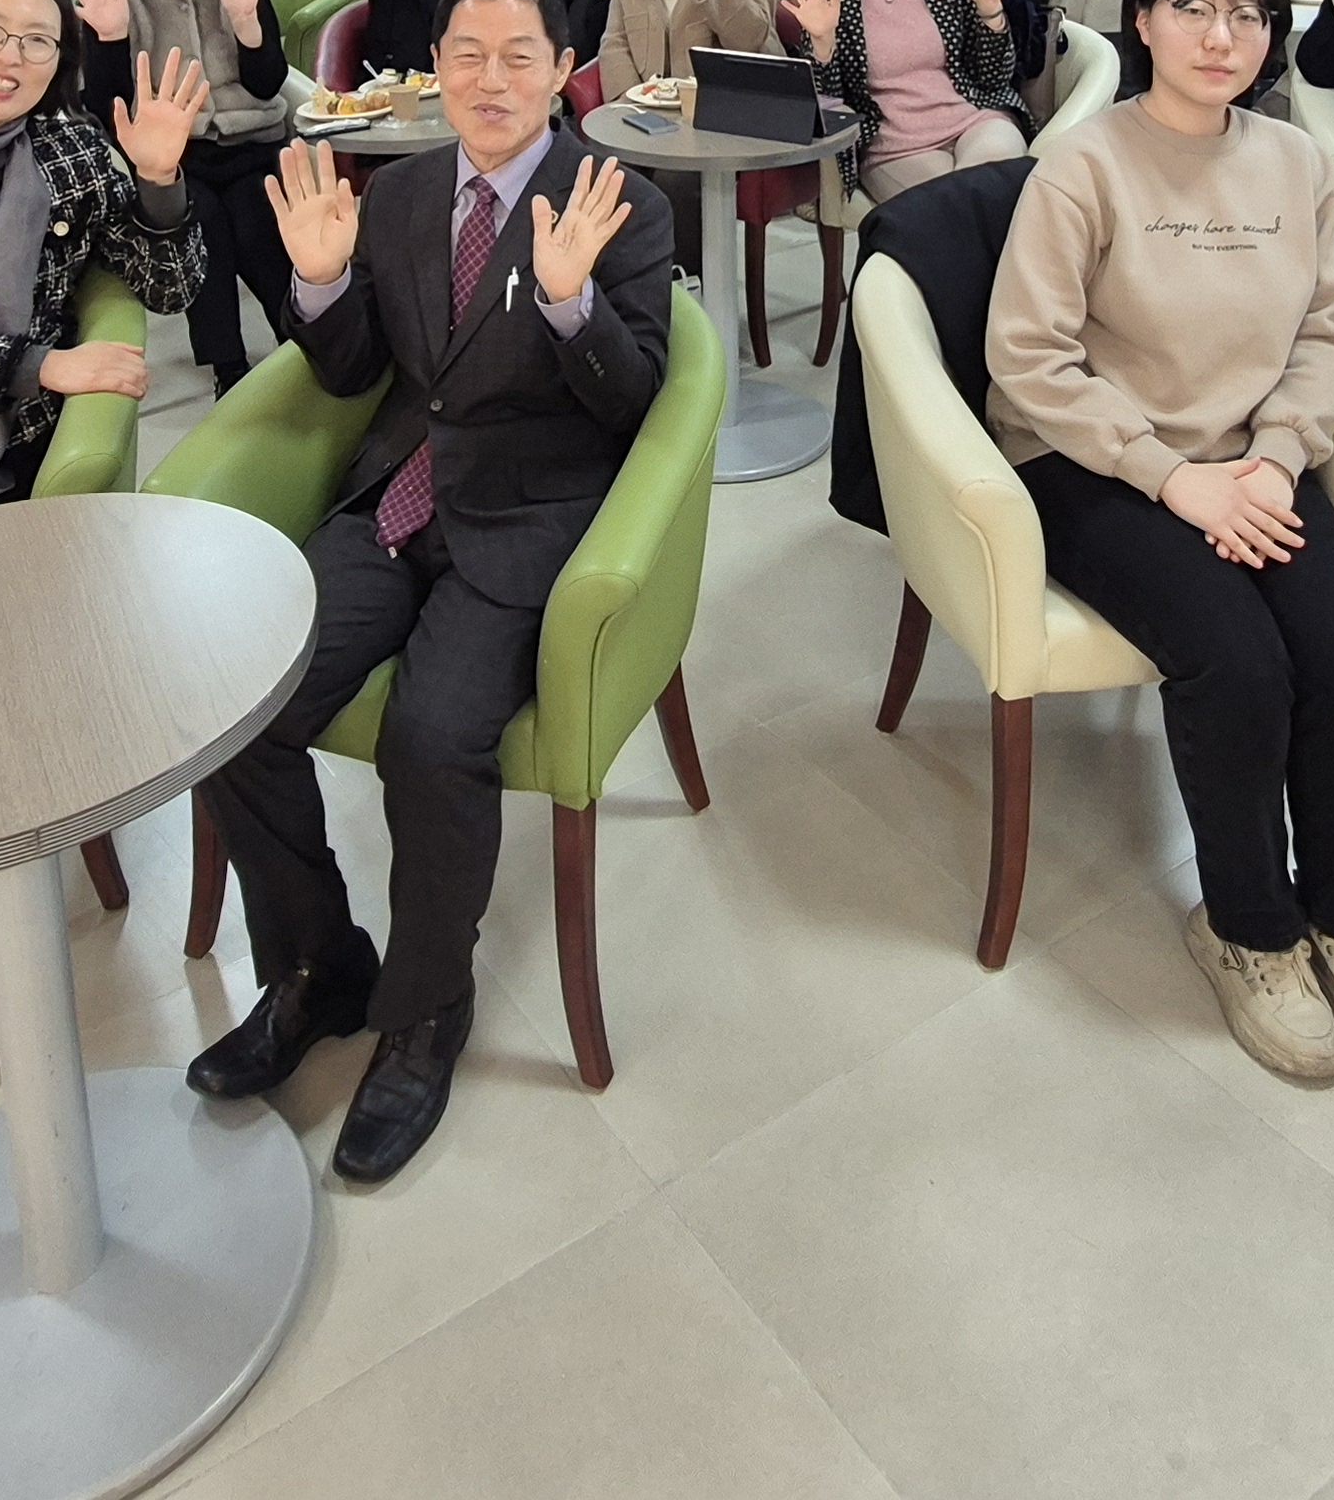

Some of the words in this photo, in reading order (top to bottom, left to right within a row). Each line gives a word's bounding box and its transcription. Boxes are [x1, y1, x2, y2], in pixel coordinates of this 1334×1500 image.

[1144, 215, 1199, 237] changes
[1203, 218, 1236, 235] have
[1216, 243, 1258, 252] EVERYTHING
